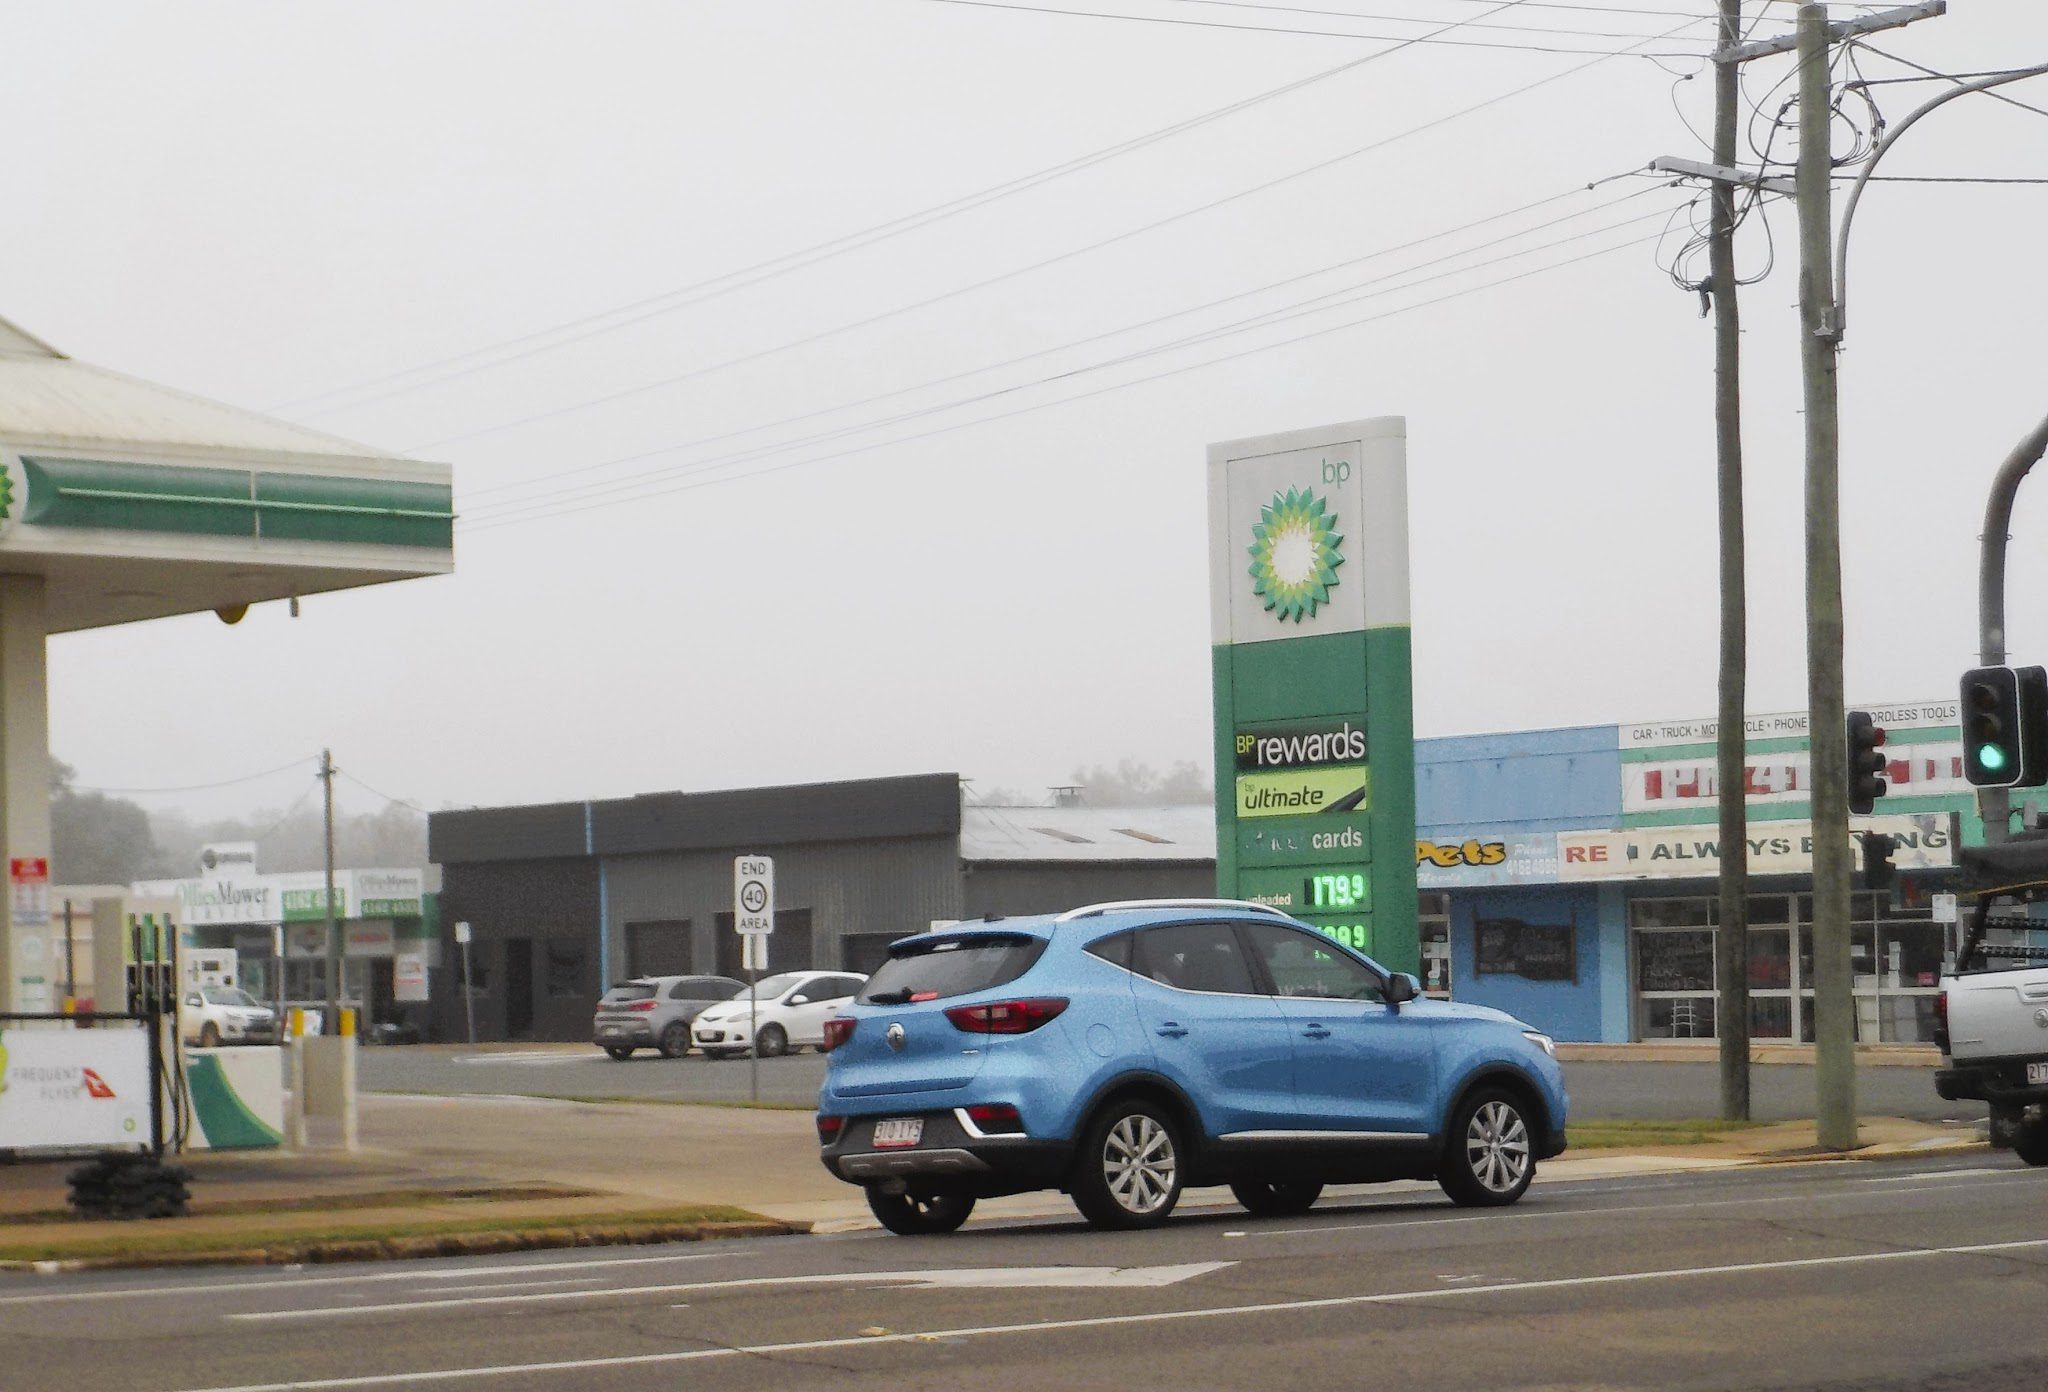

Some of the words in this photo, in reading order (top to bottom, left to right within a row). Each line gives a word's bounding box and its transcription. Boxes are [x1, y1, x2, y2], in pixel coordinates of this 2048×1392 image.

[1322, 457, 1350, 489] bp
[1632, 728, 1652, 740] CAR
[1660, 725, 1692, 738] TRUCK
[1774, 716, 1808, 729] PHONE
[1870, 708, 1918, 723] ORDLESS
[1921, 706, 1956, 719] TOOLS
[1236, 735, 1254, 754] BP
[1257, 722, 1365, 765] rewards
[1245, 785, 1324, 809] ultimate
[1312, 826, 1362, 849] cards
[1650, 838, 1790, 861] ALWYS
[742, 862, 766, 875] END
[745, 889, 763, 905] 40
[740, 917, 769, 929] AREA
